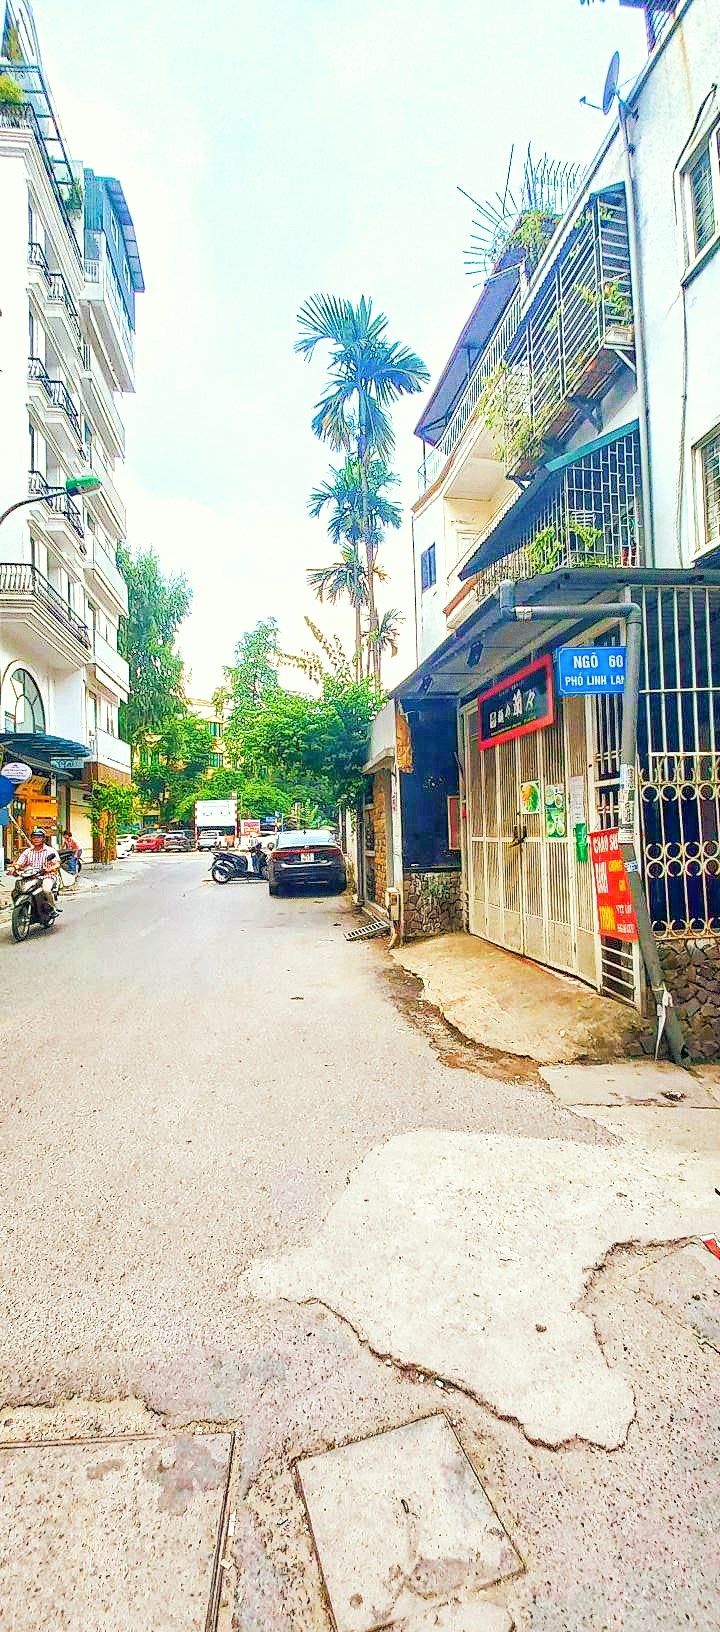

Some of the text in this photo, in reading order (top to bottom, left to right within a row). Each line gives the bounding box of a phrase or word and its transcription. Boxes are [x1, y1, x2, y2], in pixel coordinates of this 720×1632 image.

[573, 652, 624, 669] NGÕ 60
[565, 672, 583, 686] PHỐ
[587, 675, 607, 686] LINH
